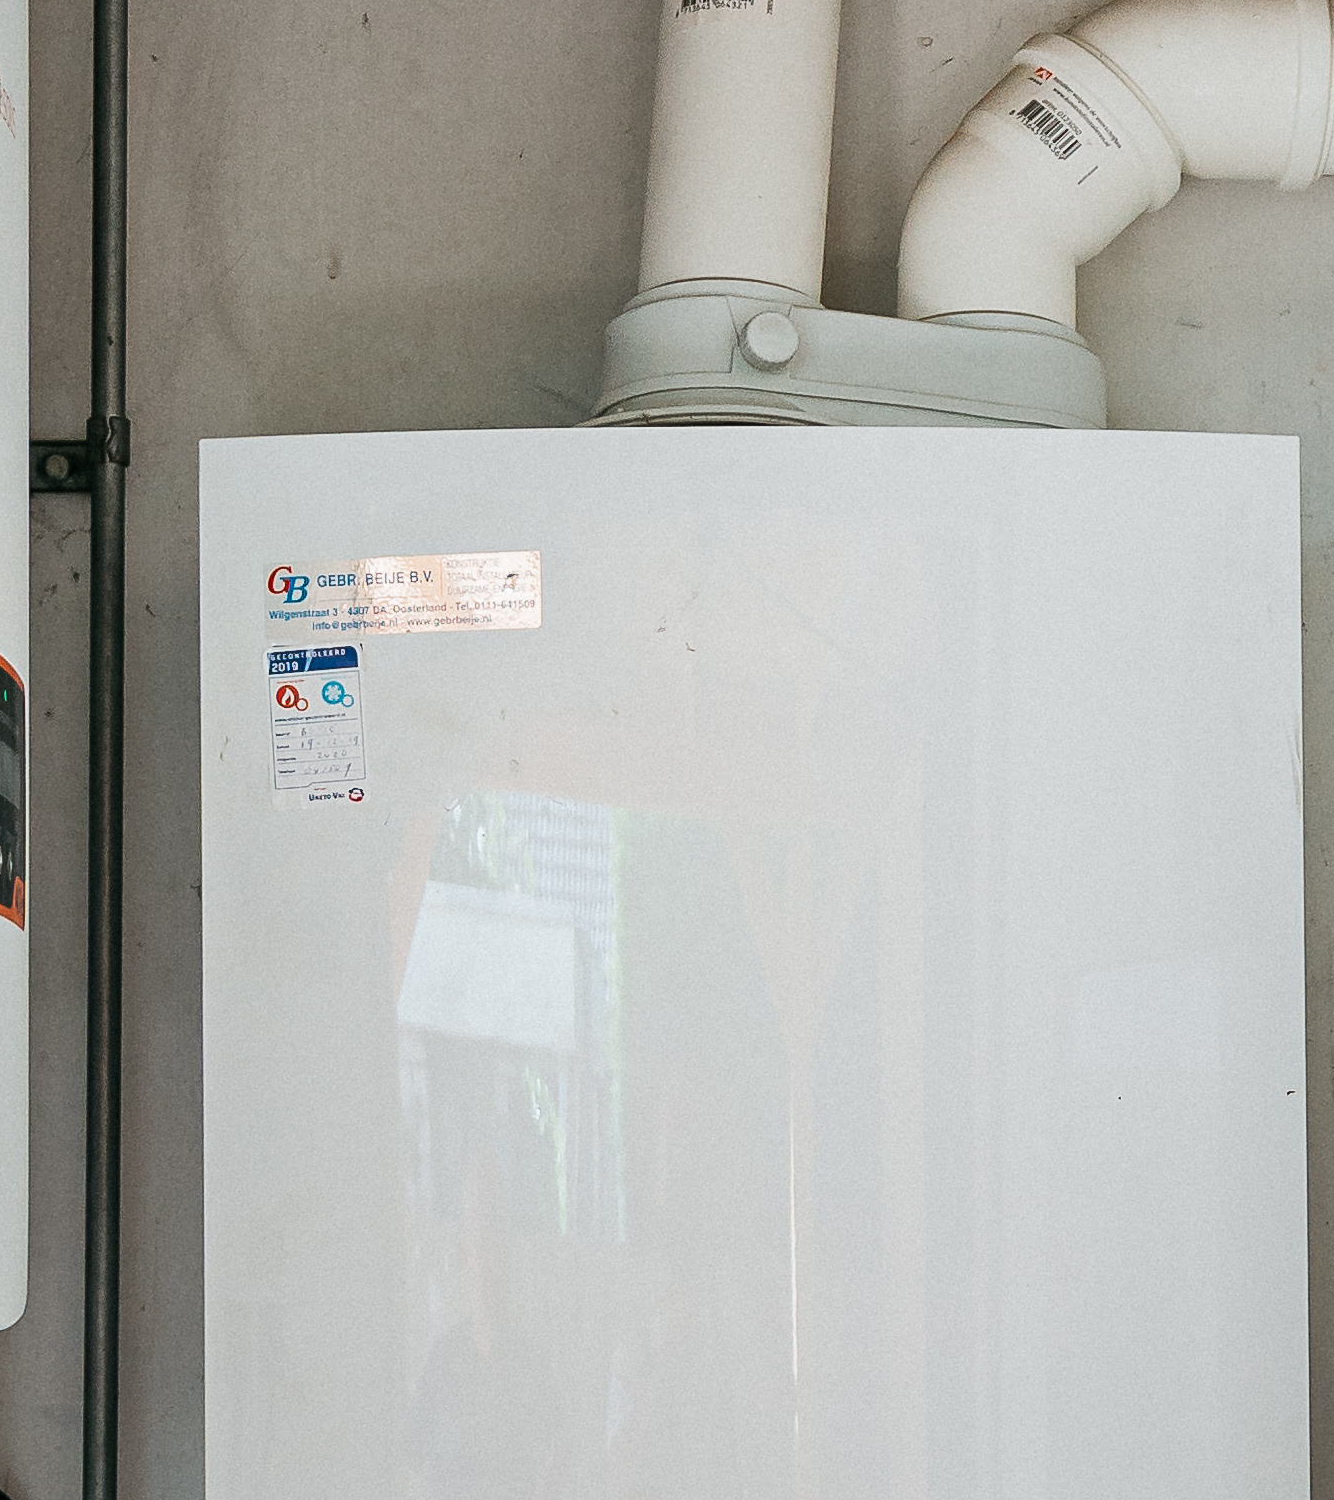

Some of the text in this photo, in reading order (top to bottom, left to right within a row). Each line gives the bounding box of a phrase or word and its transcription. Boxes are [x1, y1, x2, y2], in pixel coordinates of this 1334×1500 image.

[267, 565, 435, 604] GB GEBR. BEIJE B.V.
[269, 609, 330, 621] Wilgenstraat
[332, 608, 339, 616] 3
[347, 606, 369, 616] 4307
[393, 602, 447, 613] Oosterland
[271, 661, 299, 673] 2019
